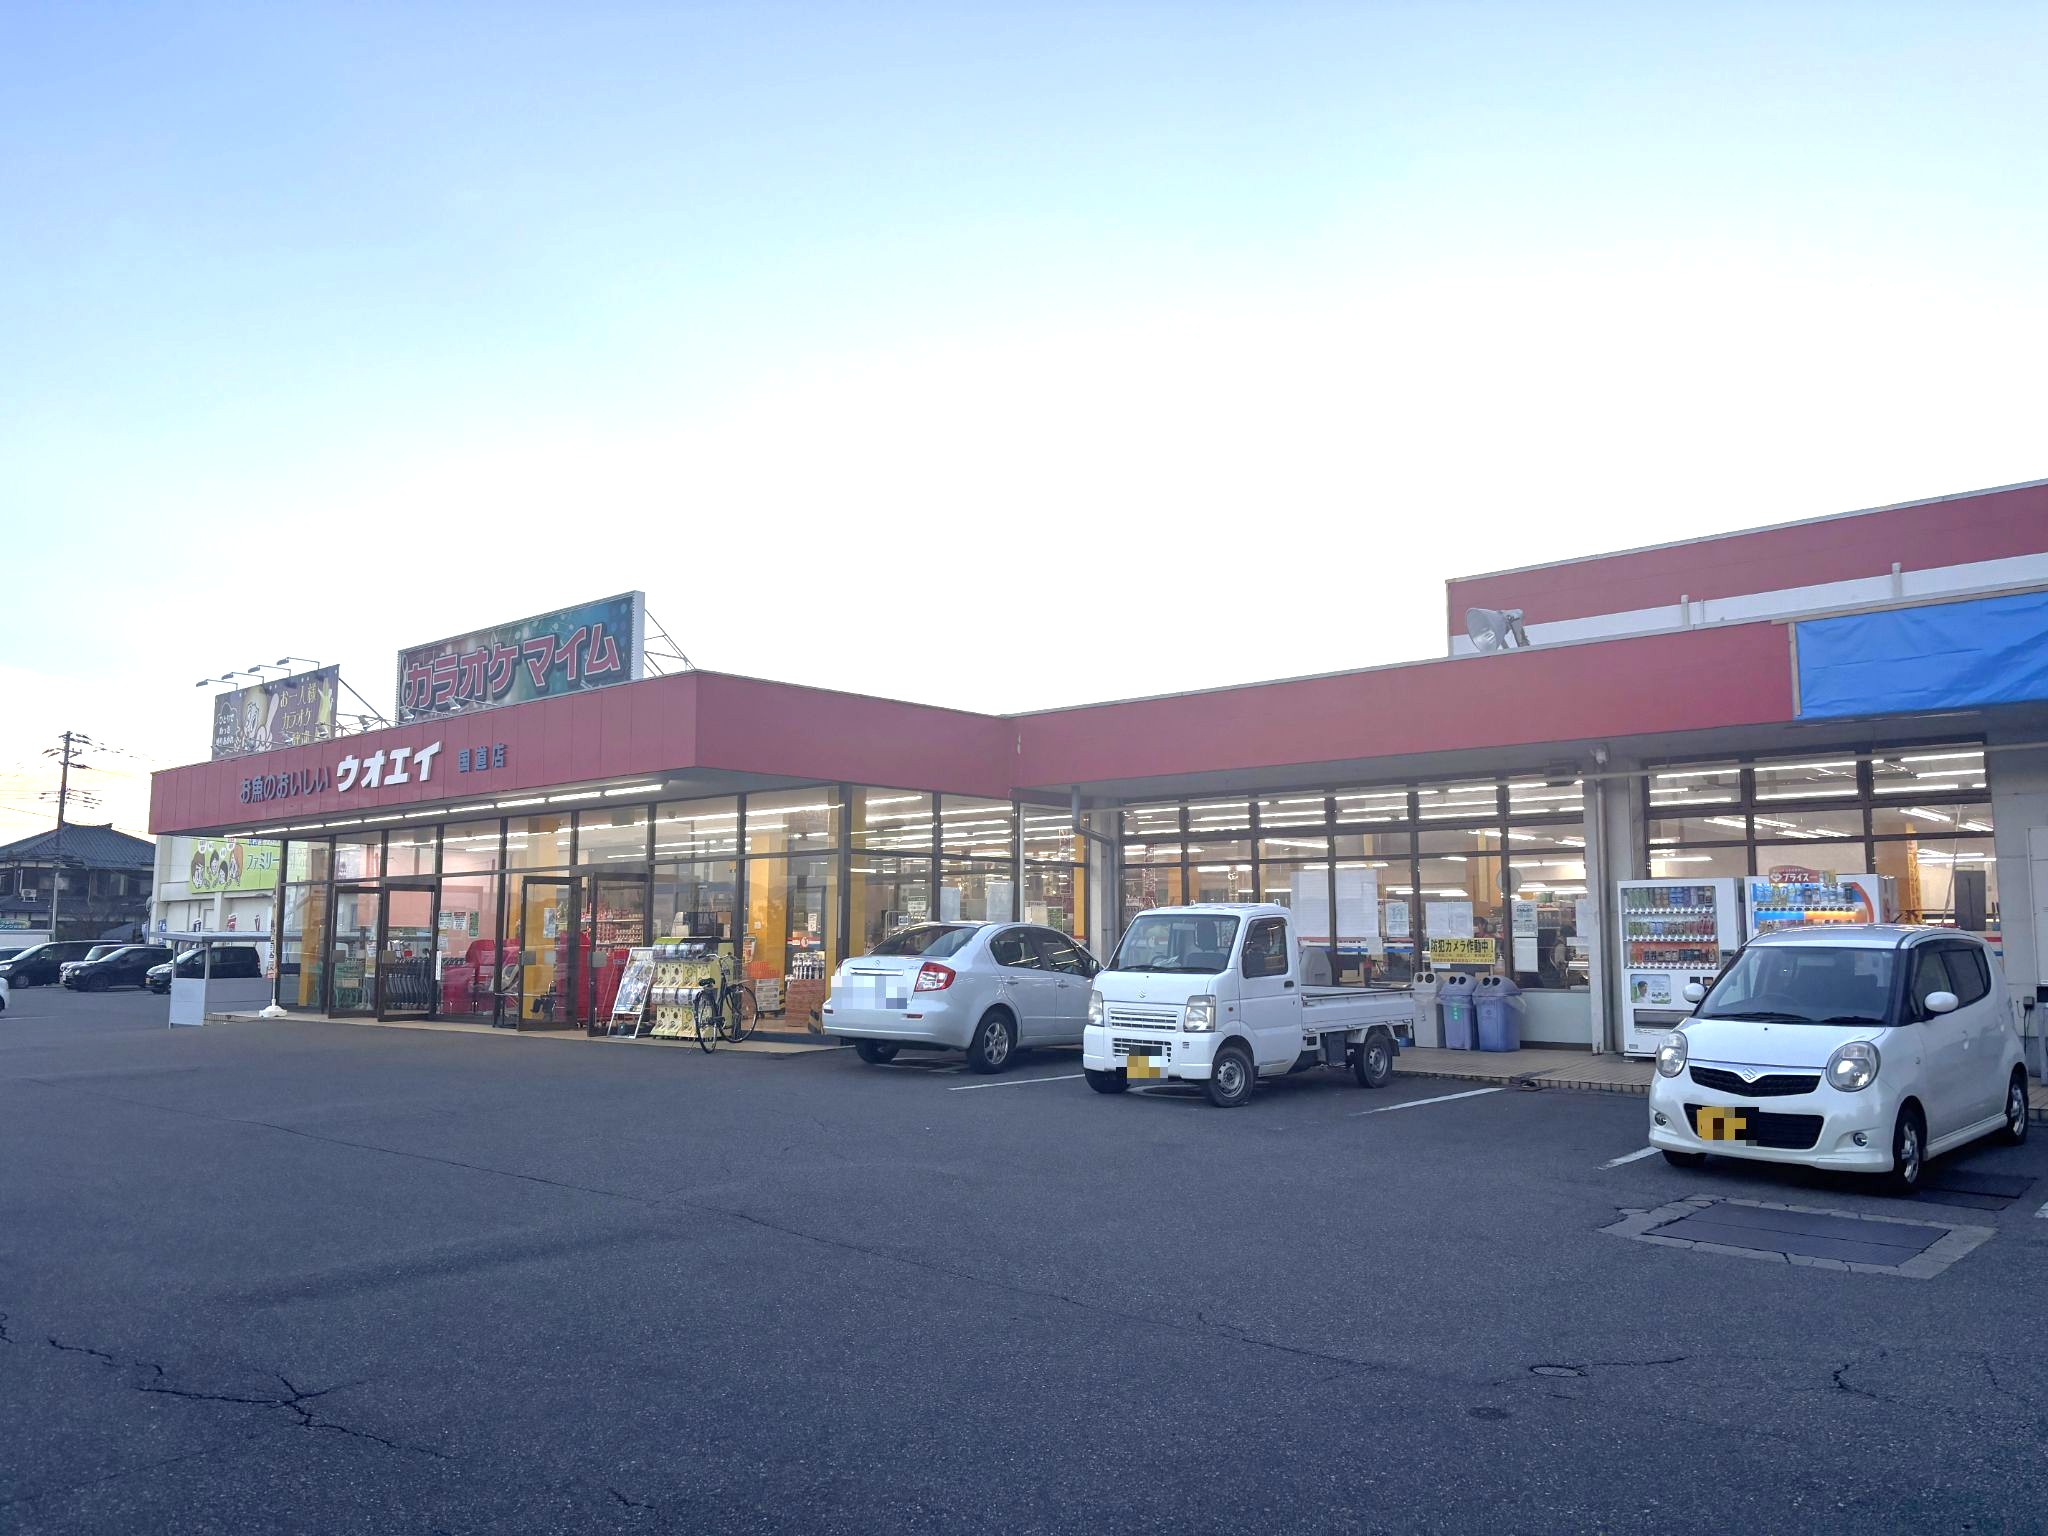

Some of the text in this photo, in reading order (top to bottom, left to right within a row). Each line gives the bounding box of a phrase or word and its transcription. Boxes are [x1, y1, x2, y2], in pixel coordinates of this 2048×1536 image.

[405, 623, 621, 709] カラオケマイム
[280, 682, 317, 708] お一人様
[282, 707, 312, 731] カラオケ
[239, 740, 507, 804] お魚のおいしい ウオエイ 国道店
